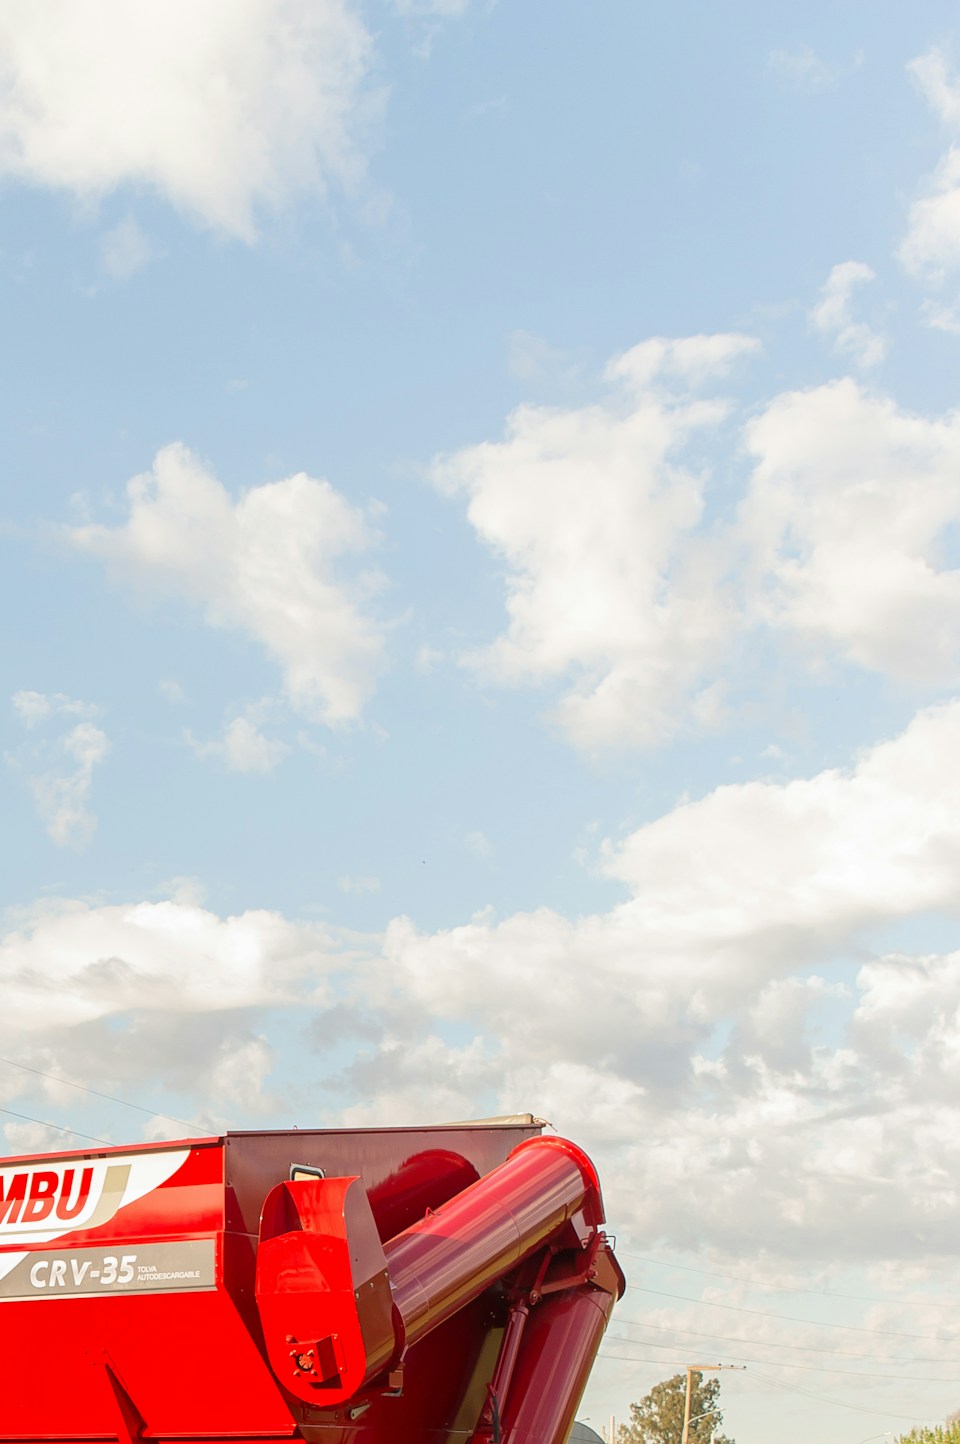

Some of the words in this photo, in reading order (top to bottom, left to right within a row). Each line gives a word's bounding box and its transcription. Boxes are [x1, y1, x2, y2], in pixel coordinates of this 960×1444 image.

[30, 1254, 137, 1288] CRV-35
[137, 1265, 157, 1273] TOLVA
[137, 1270, 200, 1281] AUTODESCARGABLE
